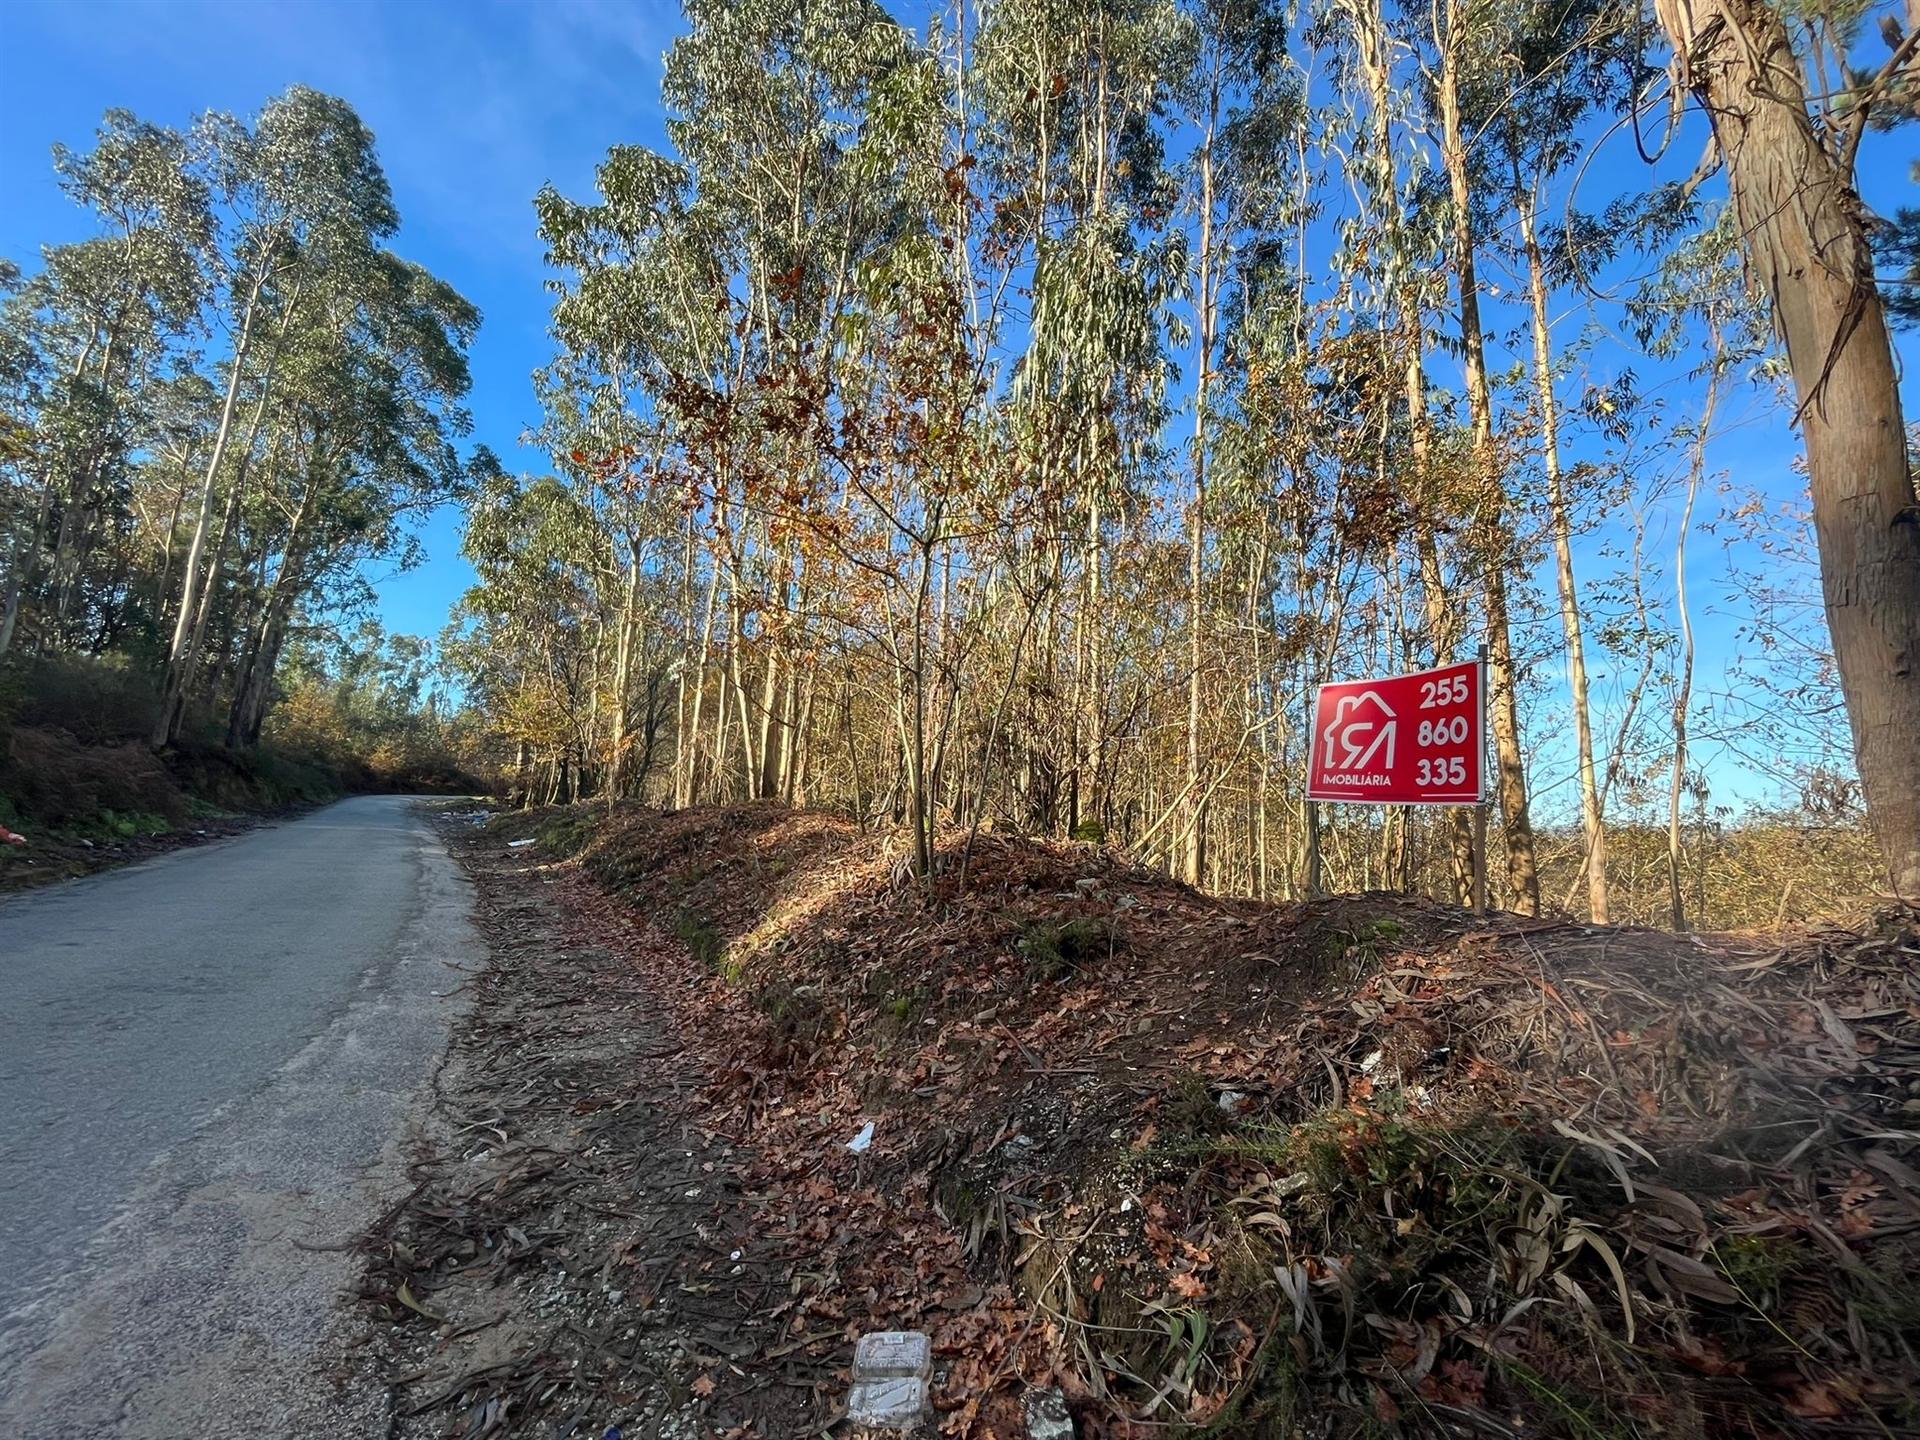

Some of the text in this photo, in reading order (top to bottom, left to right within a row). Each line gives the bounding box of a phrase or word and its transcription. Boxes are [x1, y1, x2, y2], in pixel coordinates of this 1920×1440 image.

[1419, 675, 1469, 709] 255
[1417, 715, 1468, 747] 860
[1322, 772, 1391, 786] IMOBILIÁRIA
[1416, 757, 1466, 786] 335
